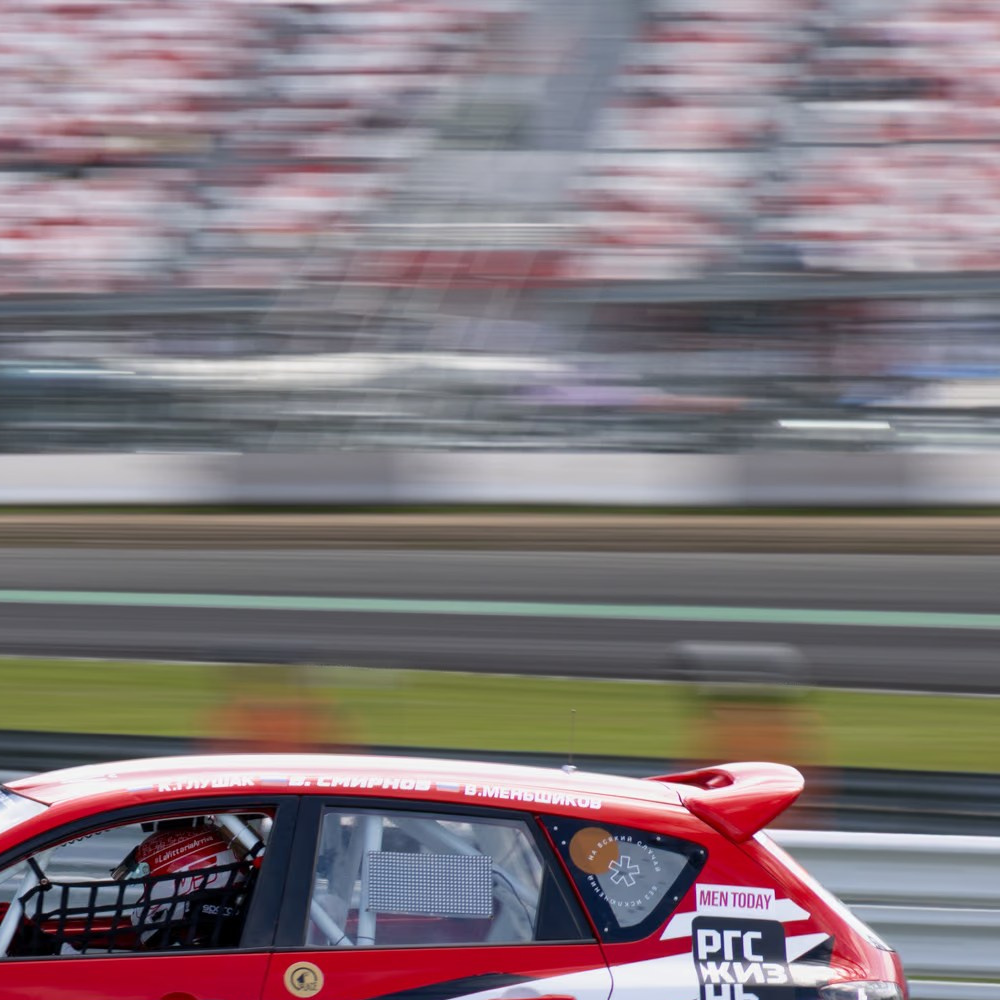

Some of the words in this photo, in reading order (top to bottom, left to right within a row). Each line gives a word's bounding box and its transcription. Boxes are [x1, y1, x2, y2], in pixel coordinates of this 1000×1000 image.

[317, 775, 431, 791] СМИРНОВ
[464, 784, 602, 810] В.МЕНЬШИКОВ
[597, 835, 633, 849] ВСЯКИЙ
[699, 890, 729, 908] MEN
[731, 892, 772, 910] TODAY
[697, 929, 764, 962] РГС
[699, 961, 789, 985] ЖИЗ
